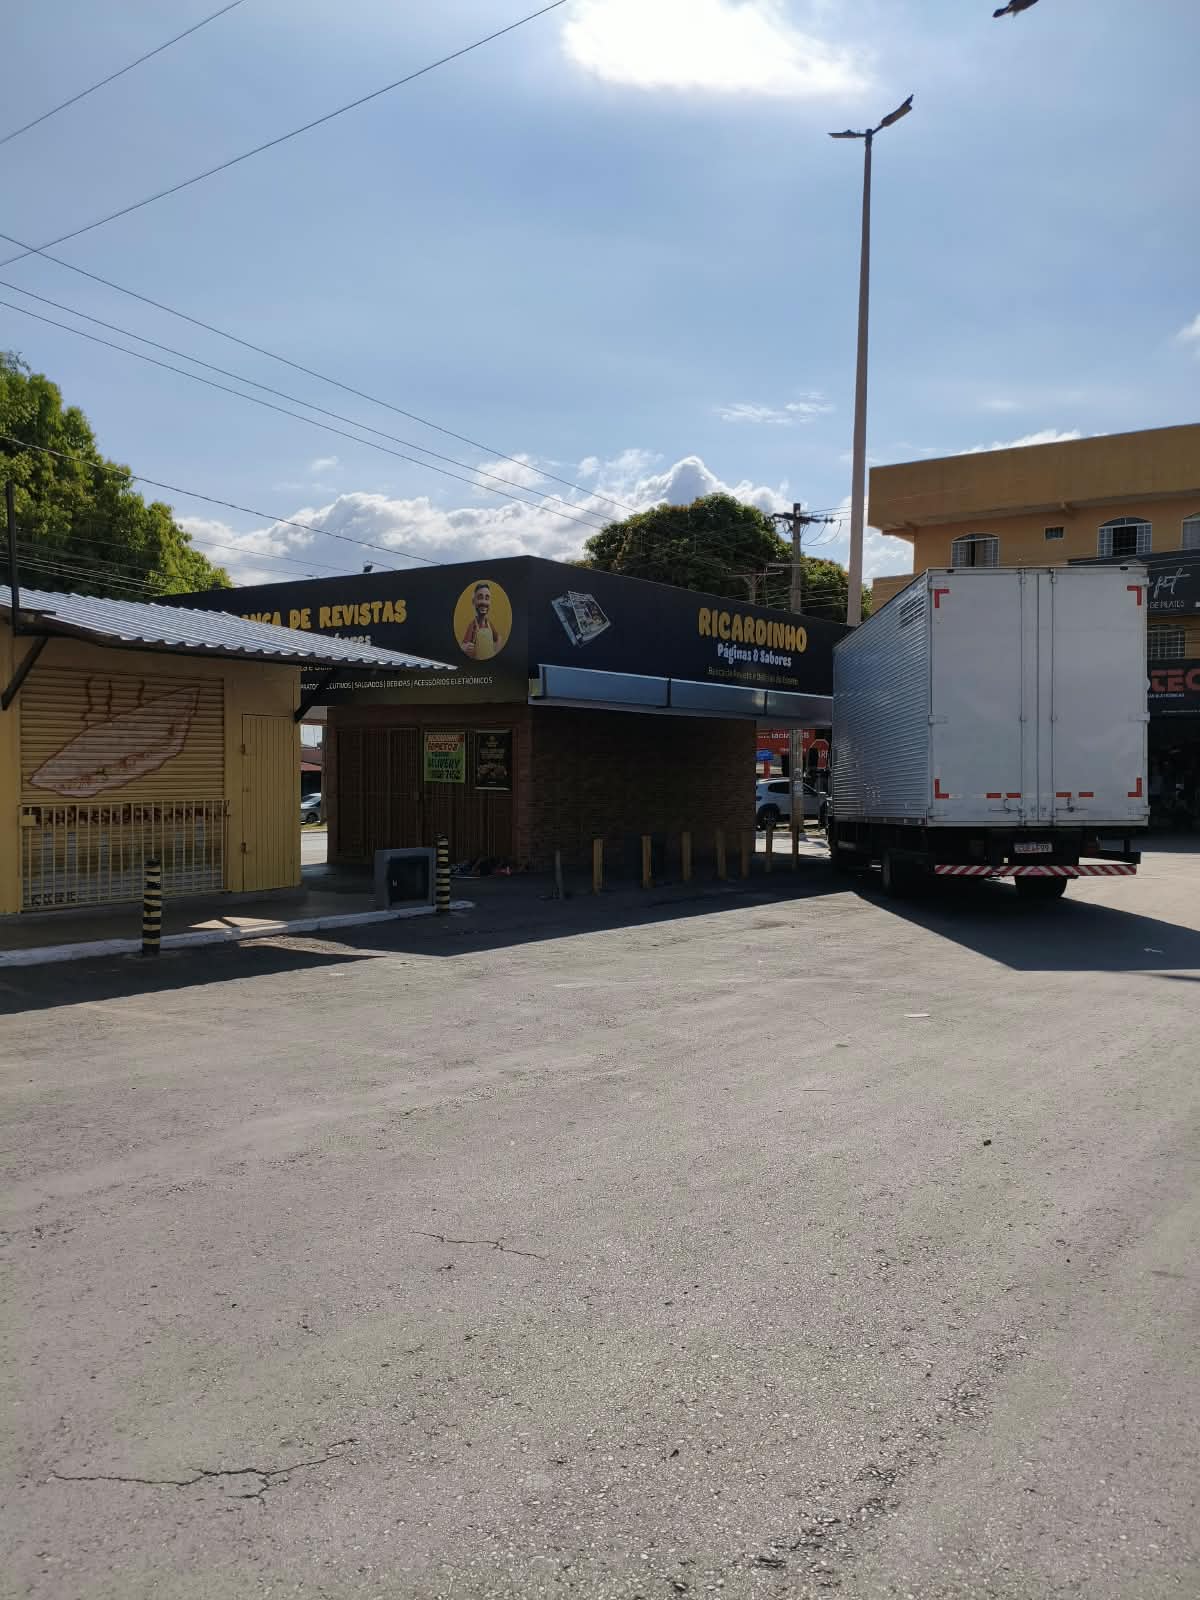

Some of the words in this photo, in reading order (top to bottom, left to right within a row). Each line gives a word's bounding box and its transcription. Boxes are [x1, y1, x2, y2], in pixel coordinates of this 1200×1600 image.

[289, 608, 311, 631] DE
[319, 599, 408, 628] REVISTAS
[698, 607, 808, 653] RICARDINHO
[717, 643, 752, 665] Páginas
[759, 650, 792, 667] Sabores
